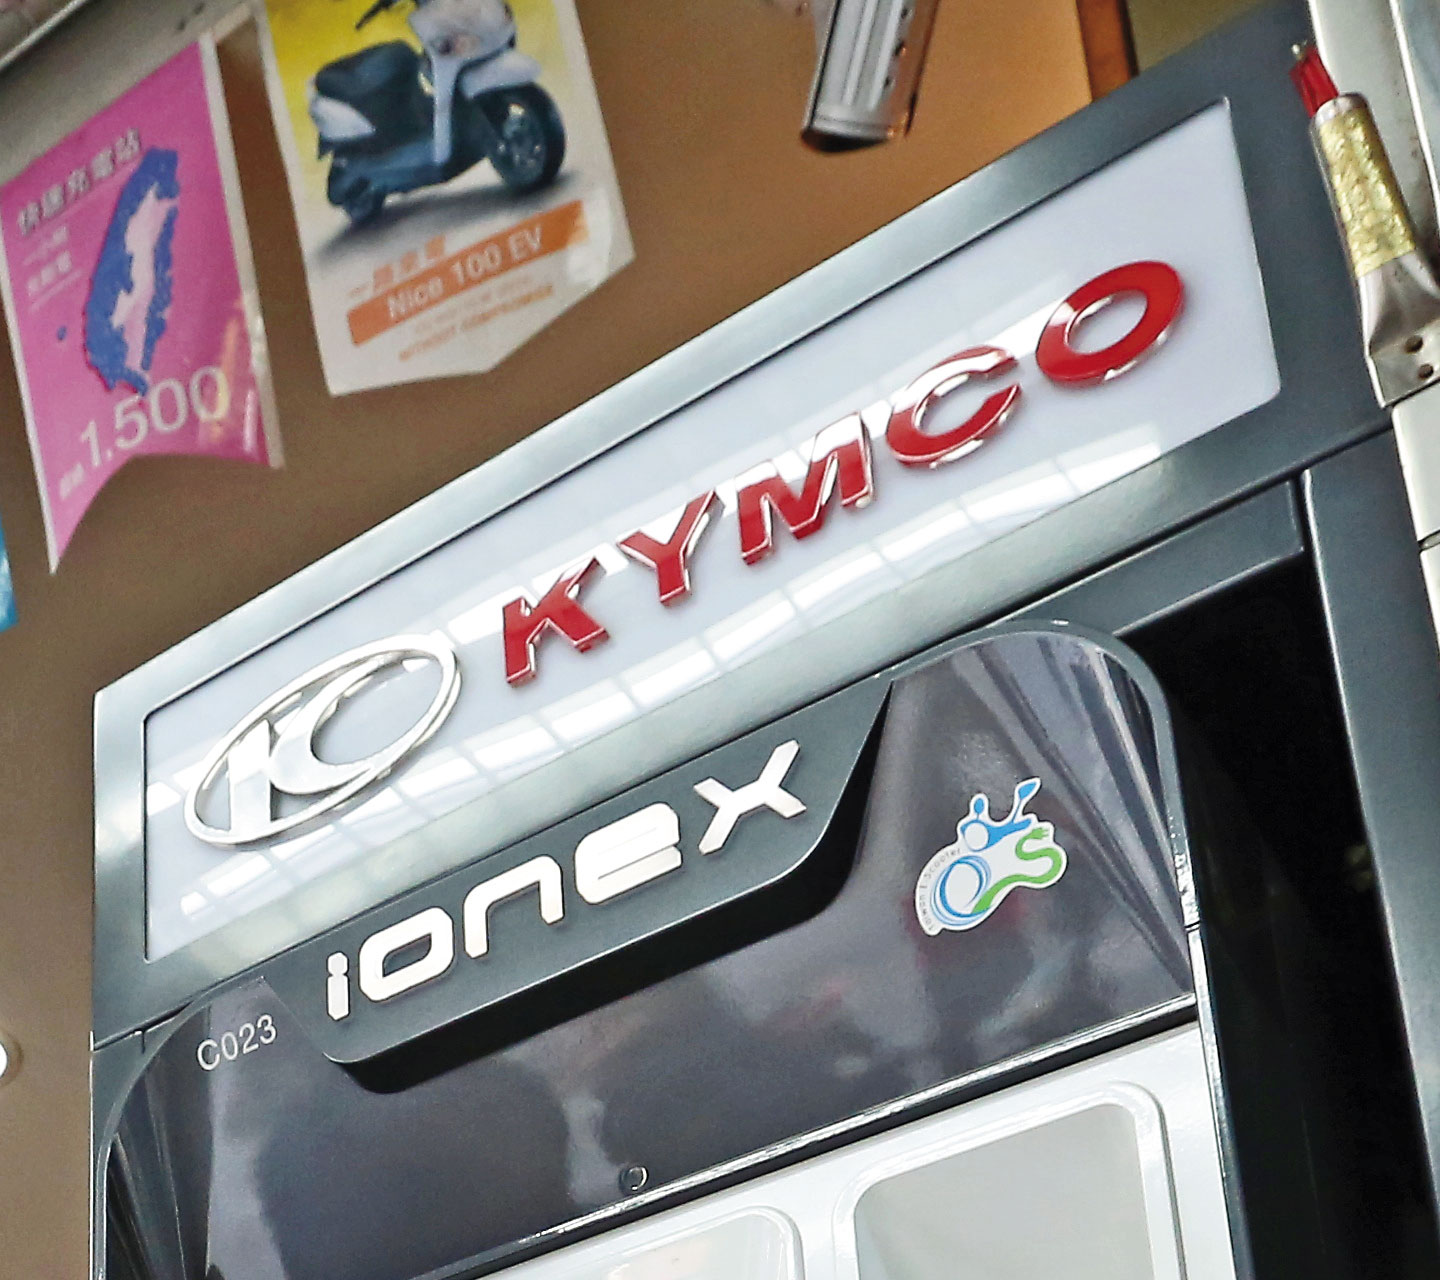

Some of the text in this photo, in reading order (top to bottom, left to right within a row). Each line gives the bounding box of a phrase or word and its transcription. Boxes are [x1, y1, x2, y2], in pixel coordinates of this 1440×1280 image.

[450, 244, 502, 285] 100
[509, 226, 541, 262] EV
[502, 260, 1184, 687] KYMCO
[327, 740, 807, 1021] ionex
[196, 1016, 278, 1072] C023
